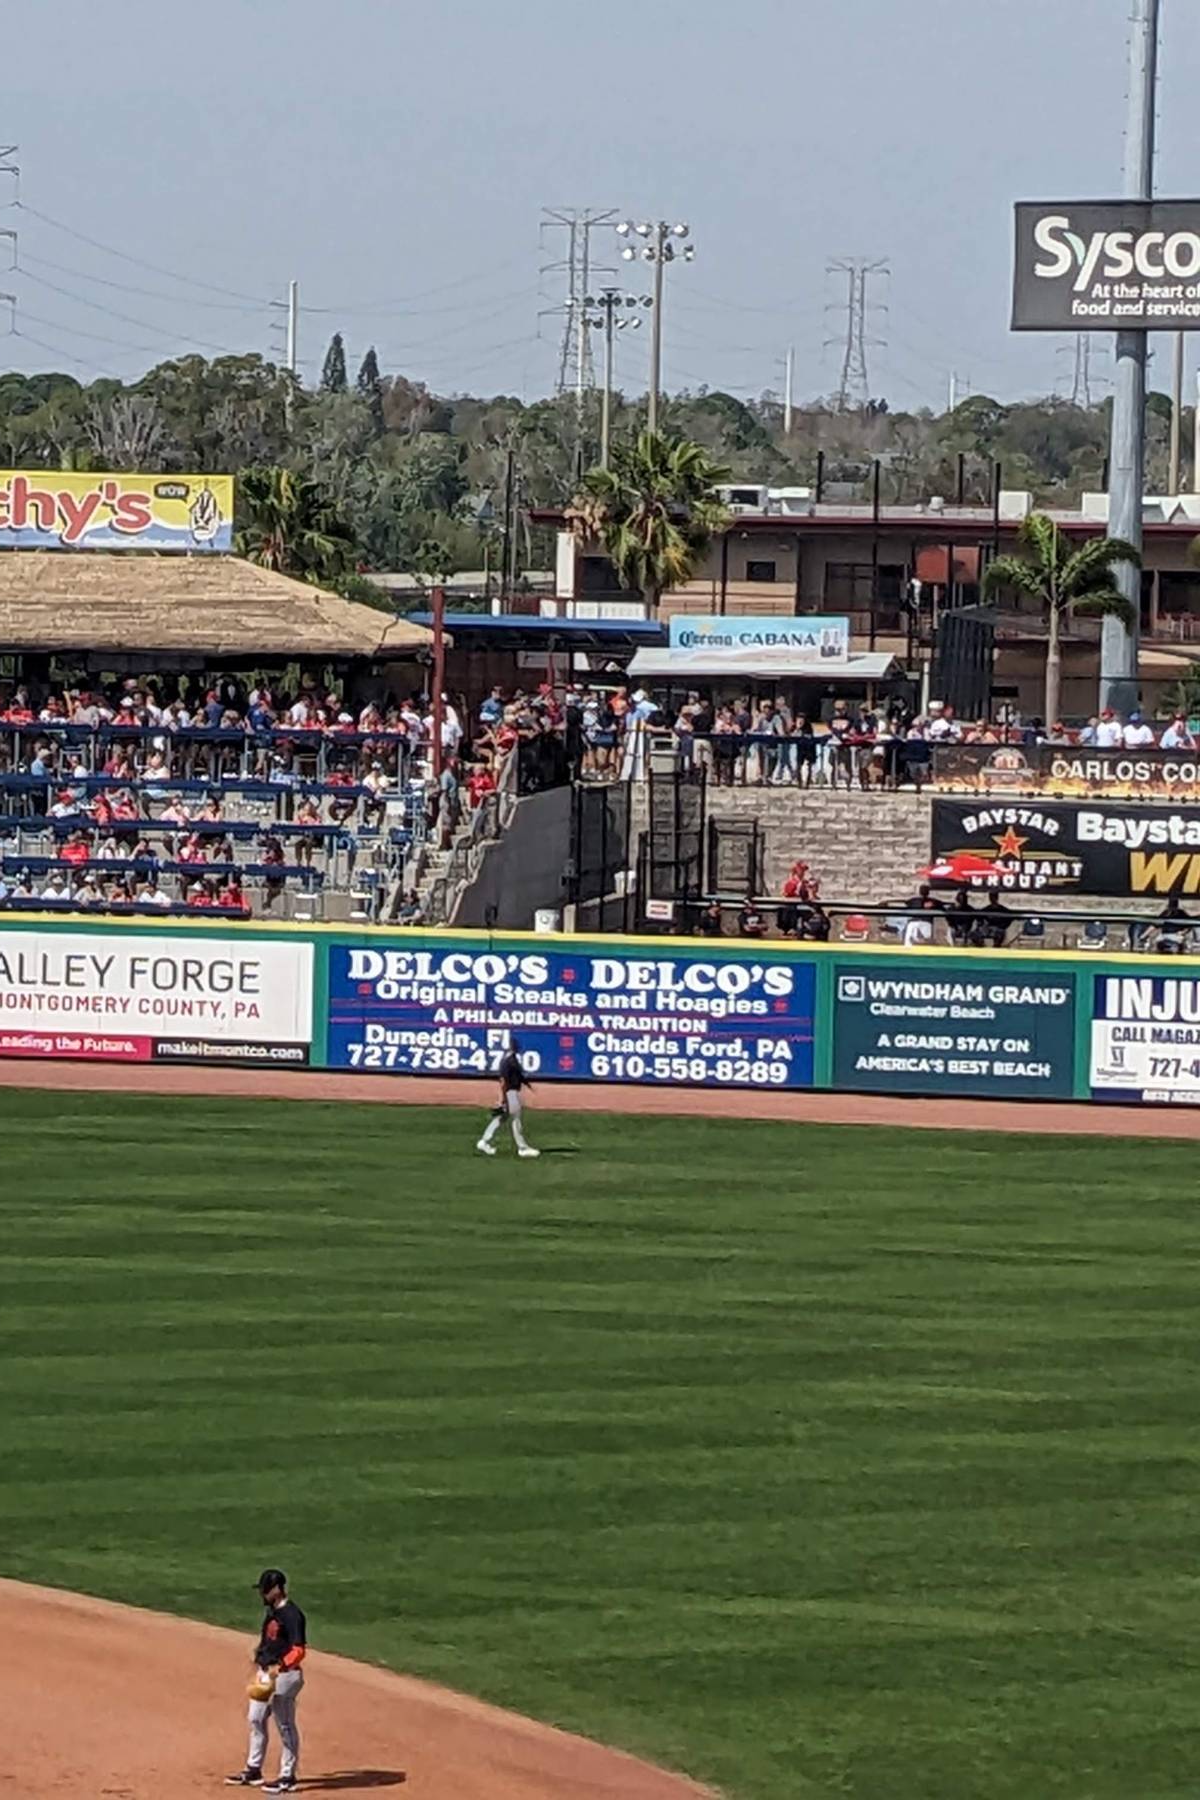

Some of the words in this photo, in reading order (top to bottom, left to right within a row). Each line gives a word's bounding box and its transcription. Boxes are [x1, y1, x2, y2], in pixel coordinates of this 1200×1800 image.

[1034, 215, 1200, 291] Sysco
[1092, 284, 1110, 298] At
[1113, 283, 1140, 298] the
[1142, 283, 1184, 298] heart
[1072, 300, 1110, 316] food
[1113, 301, 1145, 316] and
[739, 633, 816, 647] CABANA
[962, 808, 1060, 837] BAYSTAR
[128, 956, 262, 995] FORGE
[347, 949, 549, 985] DELCO'S
[589, 959, 794, 996] DELCO'S
[375, 979, 486, 1006] Original
[494, 983, 588, 1009] Steaks
[595, 990, 647, 1010] and
[655, 990, 769, 1019] Hoagies
[868, 981, 983, 1001] WYNDHAM
[988, 985, 1067, 1005] GRAND
[138, 997, 227, 1020] COUNTY,
[234, 1001, 261, 1020] PA
[433, 1007, 448, 1023] A
[452, 1009, 594, 1029] PHILADELPHIA
[598, 1014, 707, 1033] TRADITION
[869, 1002, 948, 1018] Clearwater
[950, 1004, 996, 1020] Beach
[56, 1036, 80, 1050] the
[365, 1024, 478, 1050] Dunedin,
[587, 1032, 680, 1055] Chadds
[686, 1036, 750, 1059] Ford,
[756, 1039, 793, 1060] PA
[877, 1034, 892, 1048] A
[894, 1034, 953, 1050] GRAND
[956, 1036, 1000, 1052] STAY
[1002, 1038, 1031, 1053] ON
[1111, 1026, 1147, 1043] CALL
[347, 1044, 541, 1072] 727-738-470
[590, 1055, 788, 1083] 610-558-8289
[855, 1055, 945, 1073] AMERICA'S
[947, 1059, 990, 1075] BEST
[993, 1061, 1051, 1078] BEACH
